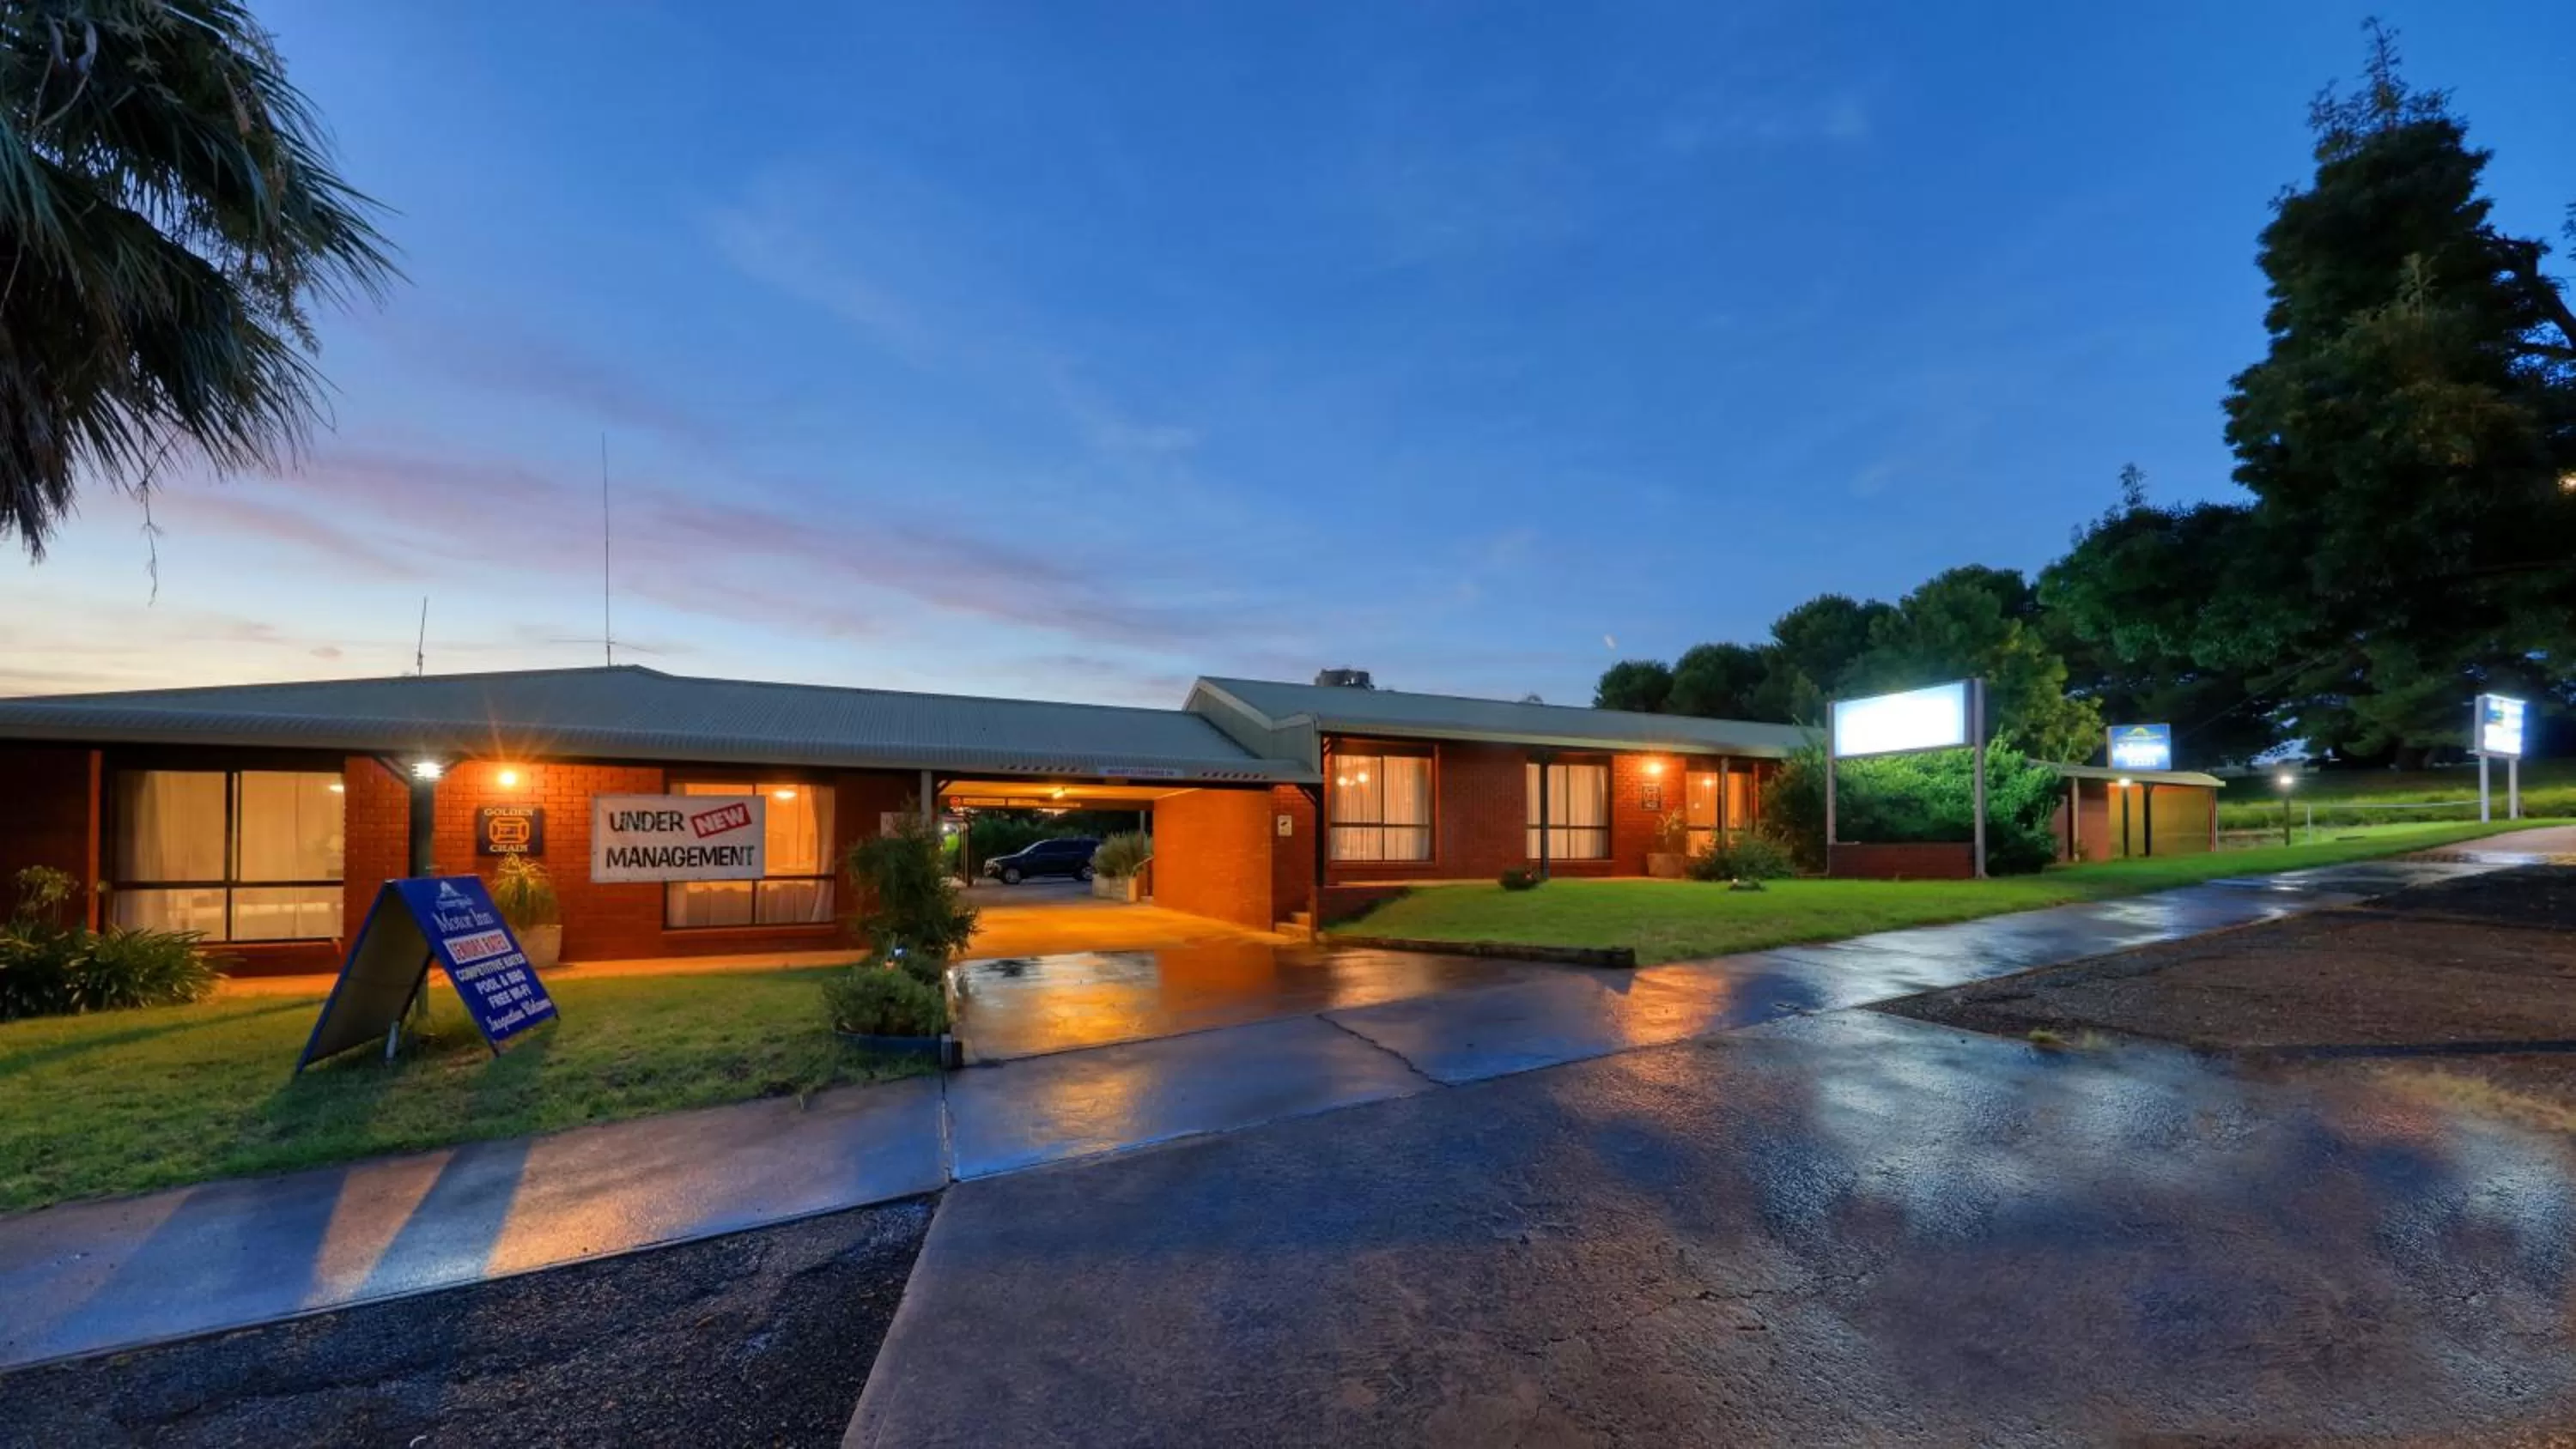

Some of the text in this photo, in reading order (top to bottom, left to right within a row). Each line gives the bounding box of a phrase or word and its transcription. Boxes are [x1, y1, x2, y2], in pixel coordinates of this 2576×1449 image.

[610, 807, 745, 834] UNDER NEW
[489, 844, 528, 852] CHAIN
[606, 846, 755, 868] MANAGEMENT
[487, 990, 513, 1009] FREE
